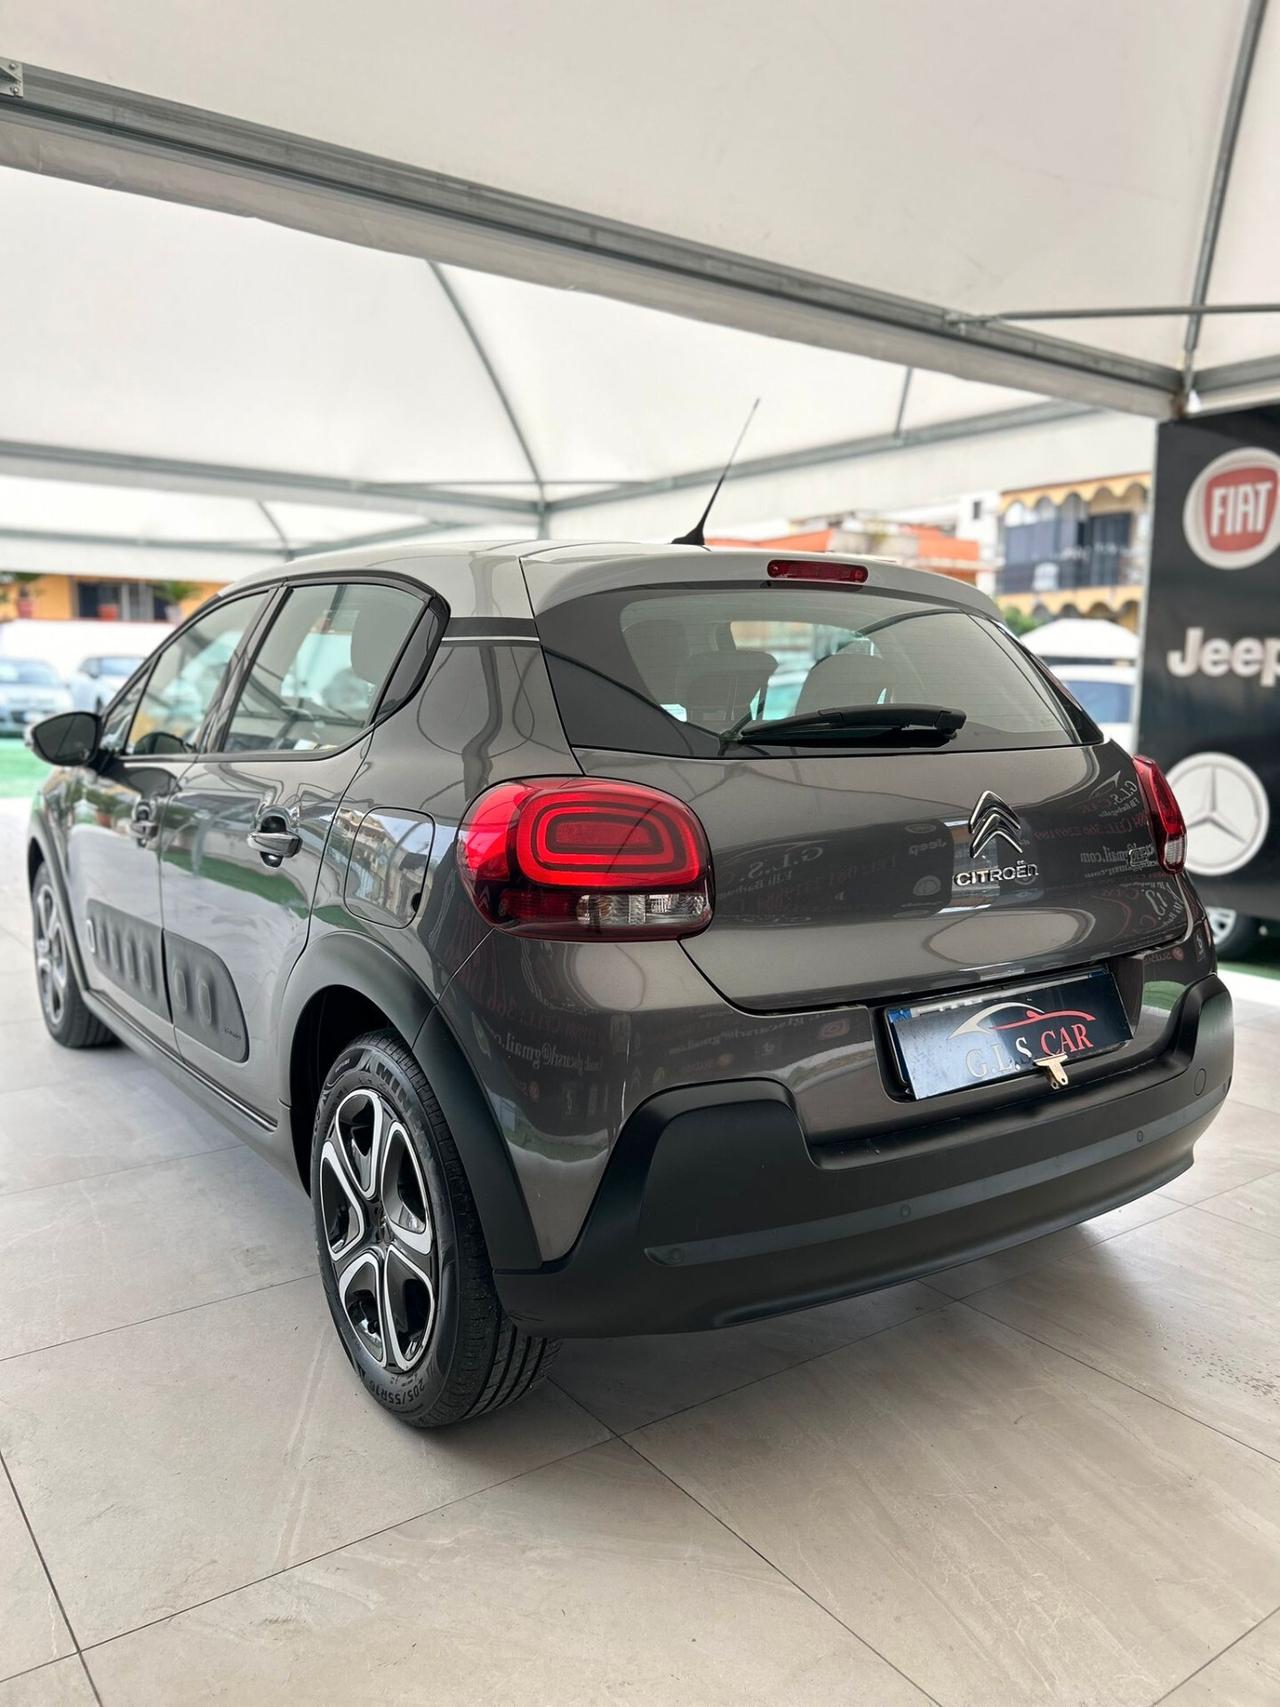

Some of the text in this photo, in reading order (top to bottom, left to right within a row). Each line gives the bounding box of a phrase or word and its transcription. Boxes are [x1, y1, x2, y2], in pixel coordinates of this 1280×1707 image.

[1210, 480, 1273, 537] FIAT
[954, 860, 1040, 886] CITROËN
[1039, 1022, 1094, 1057] CAR
